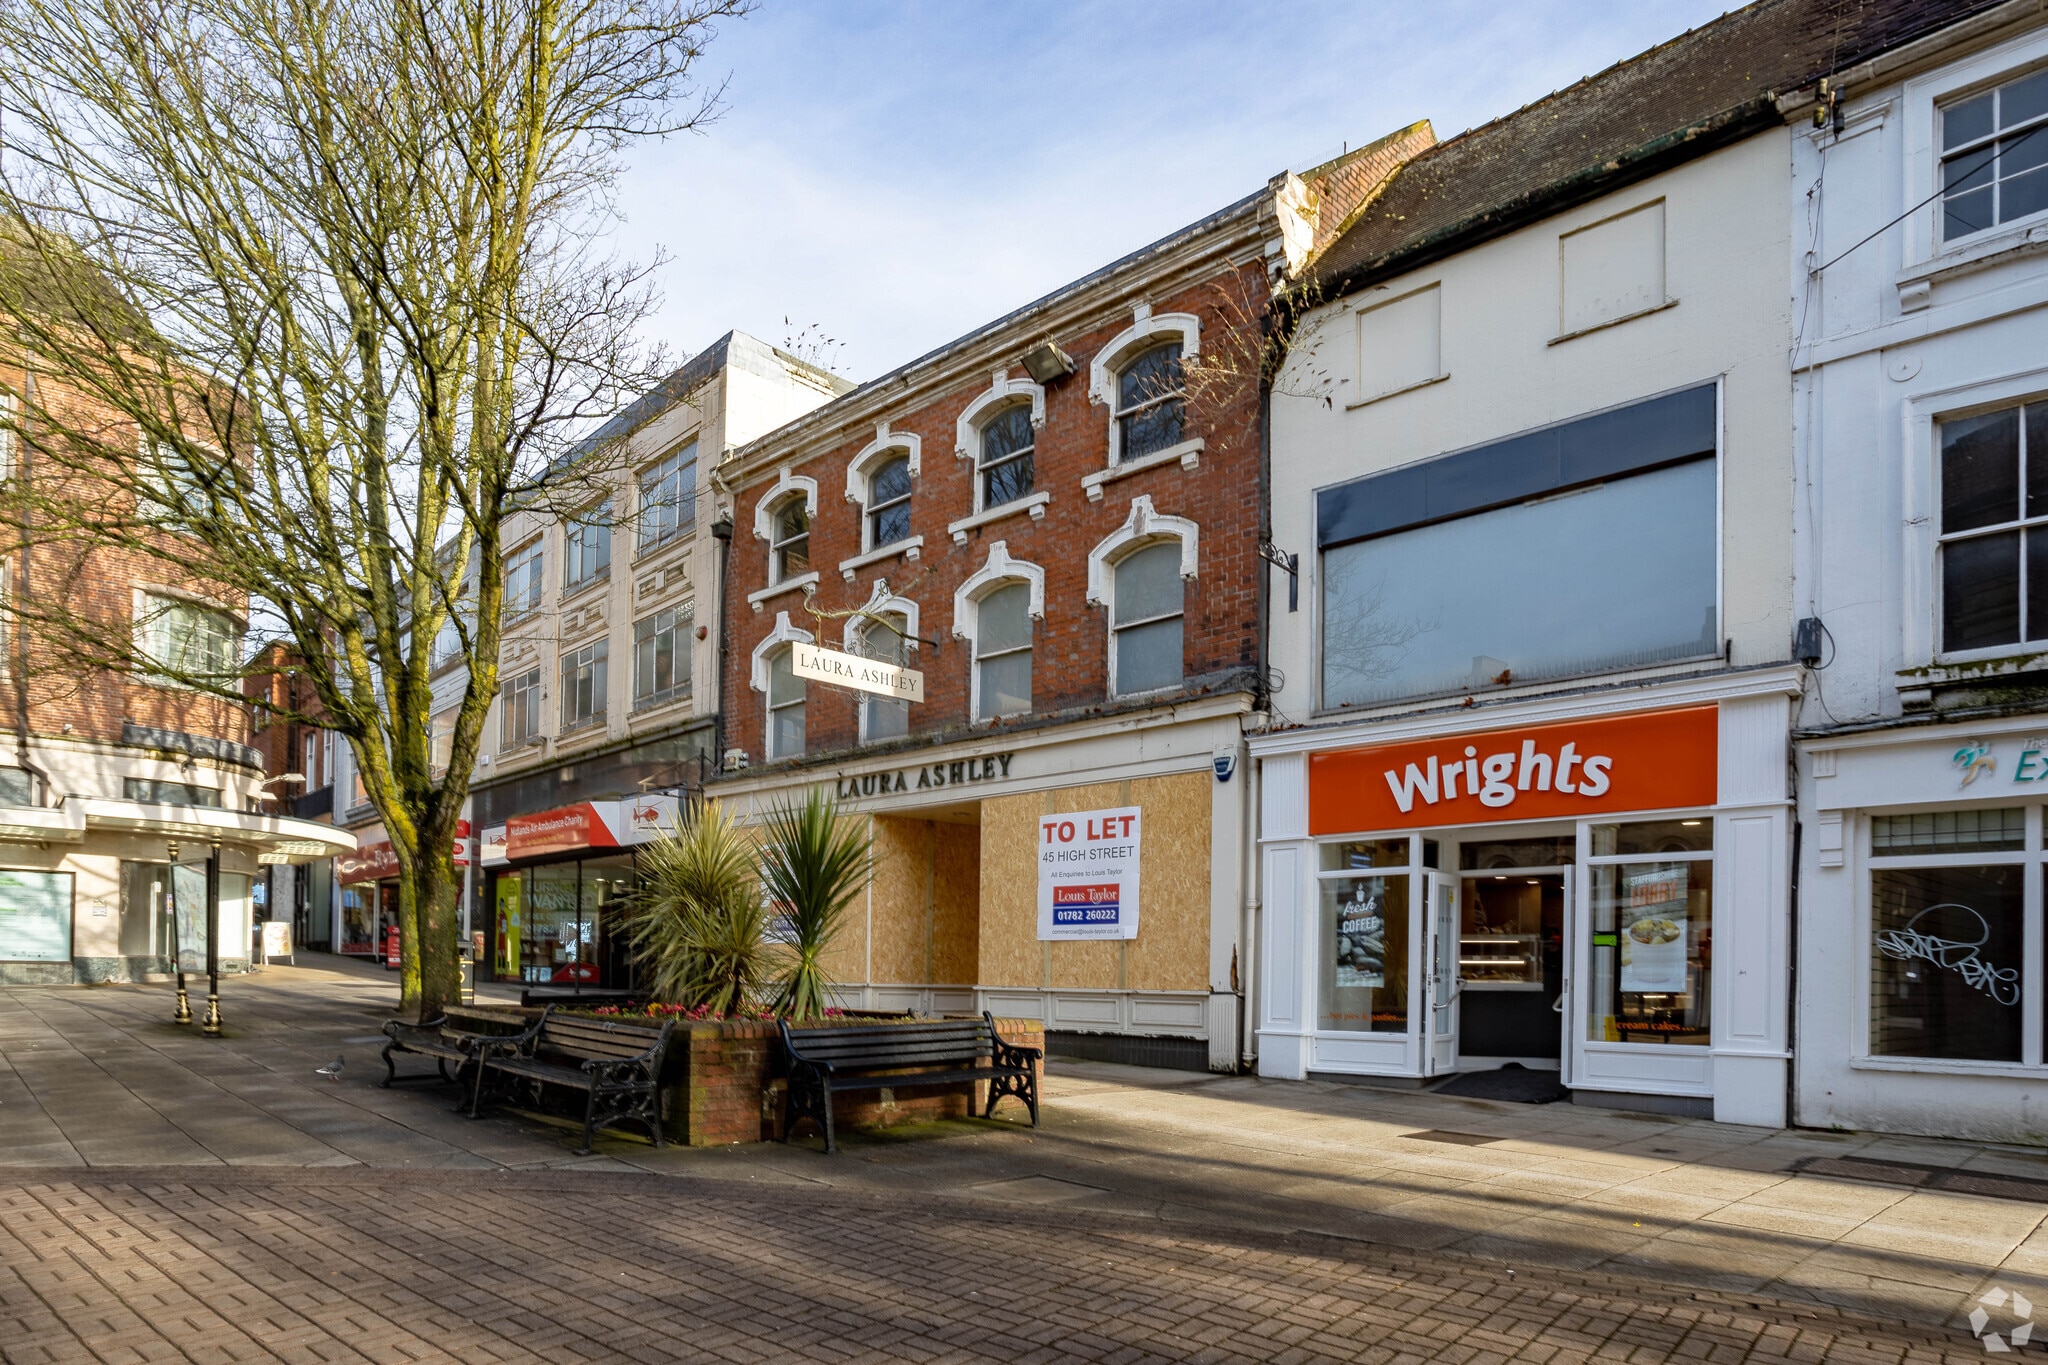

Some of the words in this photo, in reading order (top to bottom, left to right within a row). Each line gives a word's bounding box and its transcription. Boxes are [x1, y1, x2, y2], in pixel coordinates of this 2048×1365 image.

[800, 653, 854, 678] LAURA
[860, 668, 917, 692] ASHLEY
[836, 771, 908, 800] LAURA
[916, 753, 1015, 789] ASHLEY
[1384, 739, 1613, 813] Wrights
[510, 824, 530, 836] Midlands
[538, 818, 564, 831] Ambulance
[564, 813, 583, 826] Charity
[1042, 821, 1076, 845] TO
[1086, 815, 1136, 841] LET
[1042, 851, 1055, 863] 45
[1057, 849, 1086, 862] HIGH
[1089, 845, 1134, 861] STREET
[1058, 870, 1084, 880] Enquiries
[1091, 868, 1106, 877] Louis
[1107, 868, 1123, 878] Taylor
[1058, 889, 1086, 902] Louis
[1087, 887, 1118, 905] Taylor
[1342, 896, 1378, 917] fresh
[1057, 911, 1083, 921] 01782
[1085, 909, 1116, 920] 260222
[1342, 916, 1378, 934] COFFEE
